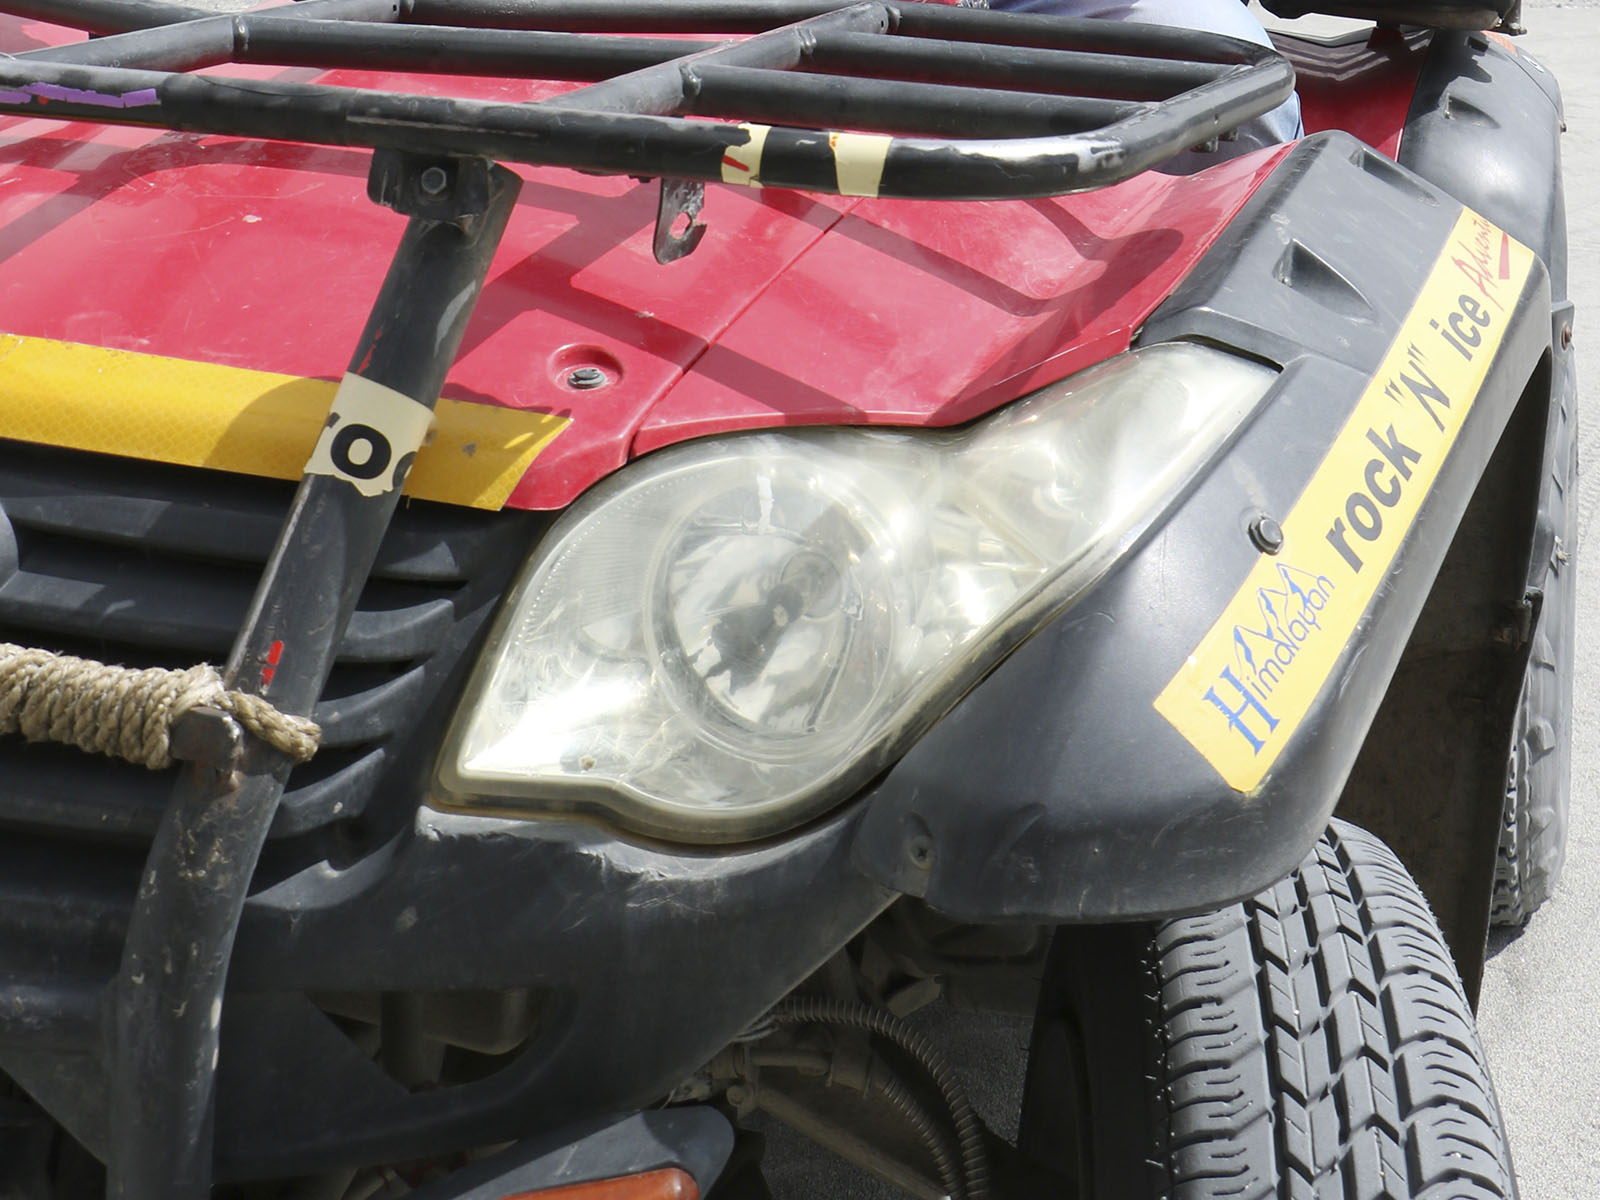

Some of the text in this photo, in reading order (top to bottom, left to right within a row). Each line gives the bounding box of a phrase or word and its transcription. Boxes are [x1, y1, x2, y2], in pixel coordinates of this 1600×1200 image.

[1202, 574, 1336, 757] Himalayan
[1325, 424, 1422, 574] rock
[1429, 294, 1491, 362] ice
